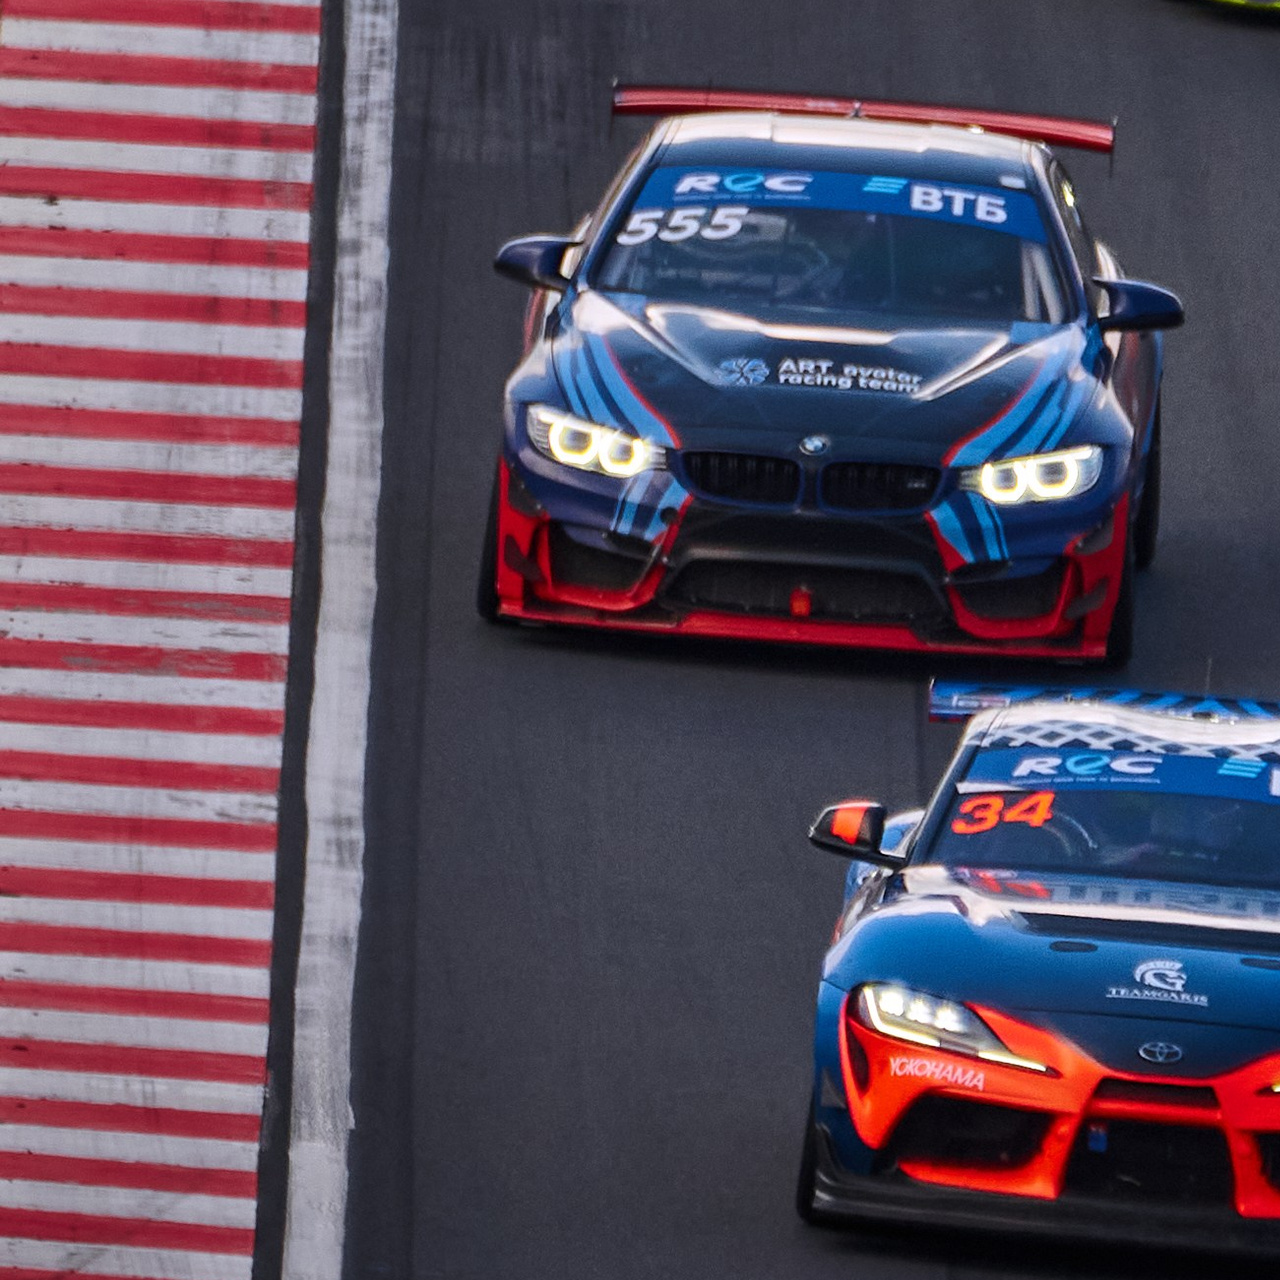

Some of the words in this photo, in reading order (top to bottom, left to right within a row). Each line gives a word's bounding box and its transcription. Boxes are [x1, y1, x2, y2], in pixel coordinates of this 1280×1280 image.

[909, 185, 1008, 224] ВТБ
[616, 206, 750, 246] 555
[779, 357, 835, 375] ART
[779, 373, 853, 390] racing
[858, 376, 921, 394] team
[951, 789, 1056, 835] 34
[889, 1057, 985, 1092] YOKOHAMA
